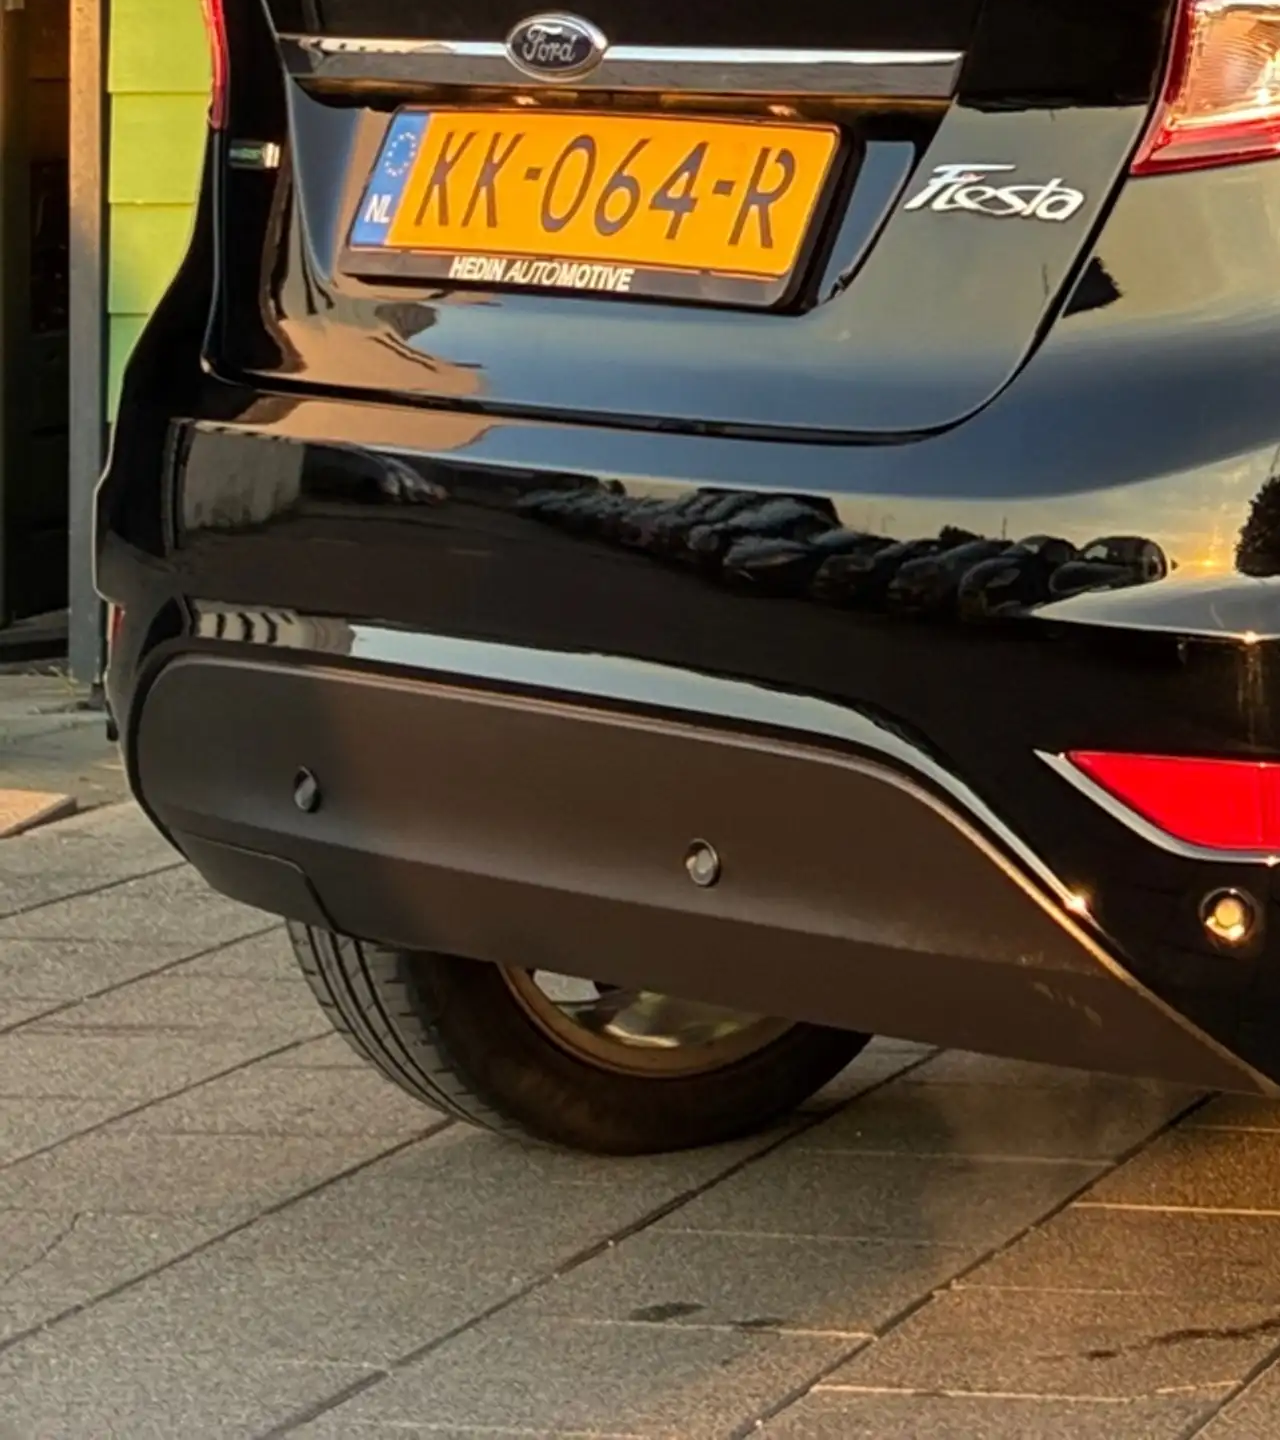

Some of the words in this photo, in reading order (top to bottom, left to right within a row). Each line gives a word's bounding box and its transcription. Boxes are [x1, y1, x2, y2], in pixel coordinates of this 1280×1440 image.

[522, 24, 579, 62] Ford
[414, 131, 796, 248] KK-064-R
[903, 164, 1084, 221] Fiesta
[364, 195, 392, 223] NL
[449, 256, 506, 281] HEDIN
[504, 260, 634, 291] AUTOMOTIVE
